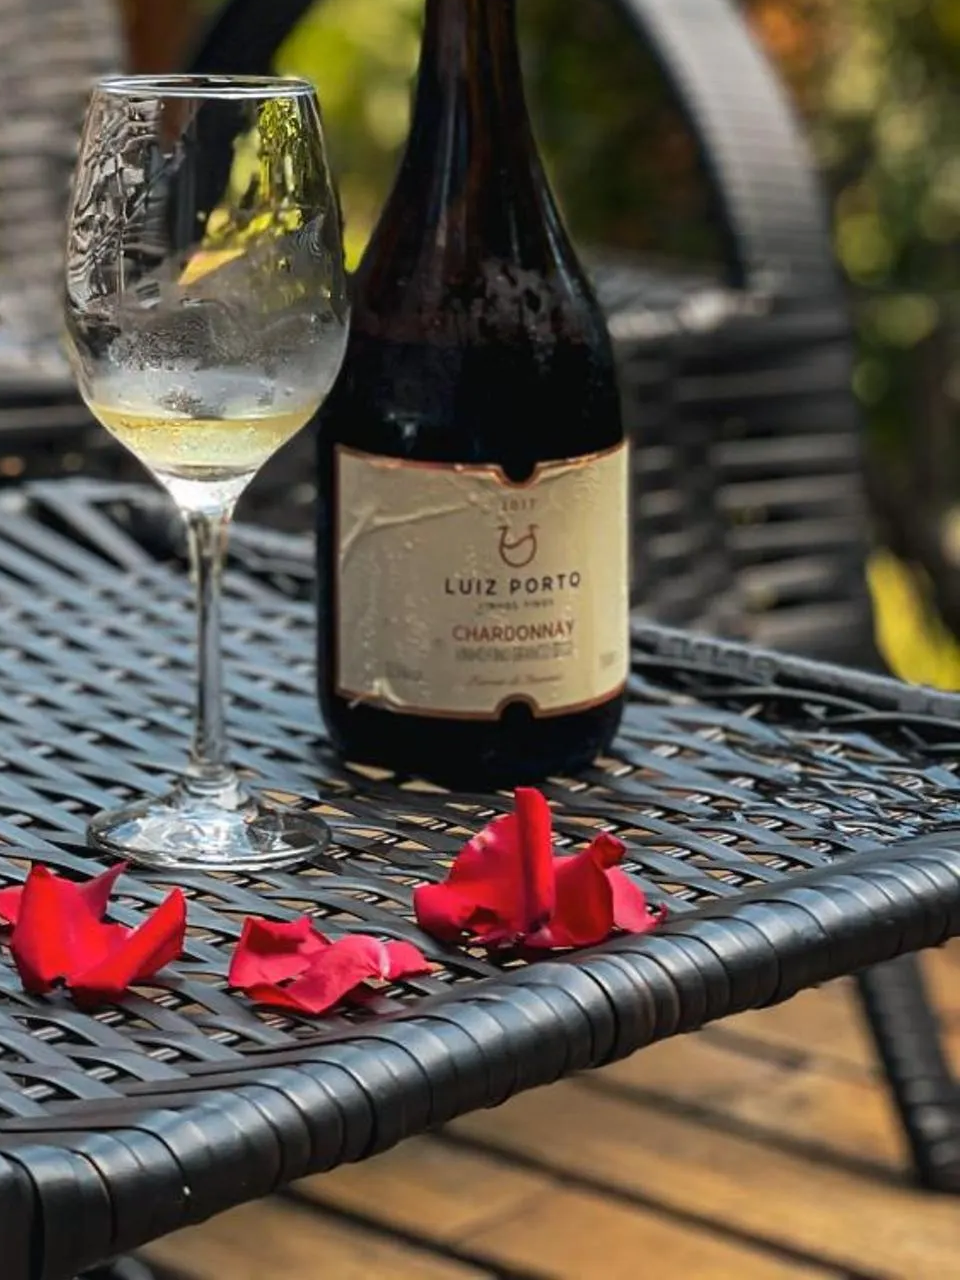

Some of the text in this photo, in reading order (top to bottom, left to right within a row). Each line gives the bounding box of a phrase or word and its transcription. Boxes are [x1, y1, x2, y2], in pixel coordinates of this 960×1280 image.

[444, 571, 581, 596] LUIZ PORTO
[452, 620, 574, 642] CHARDONNAY
